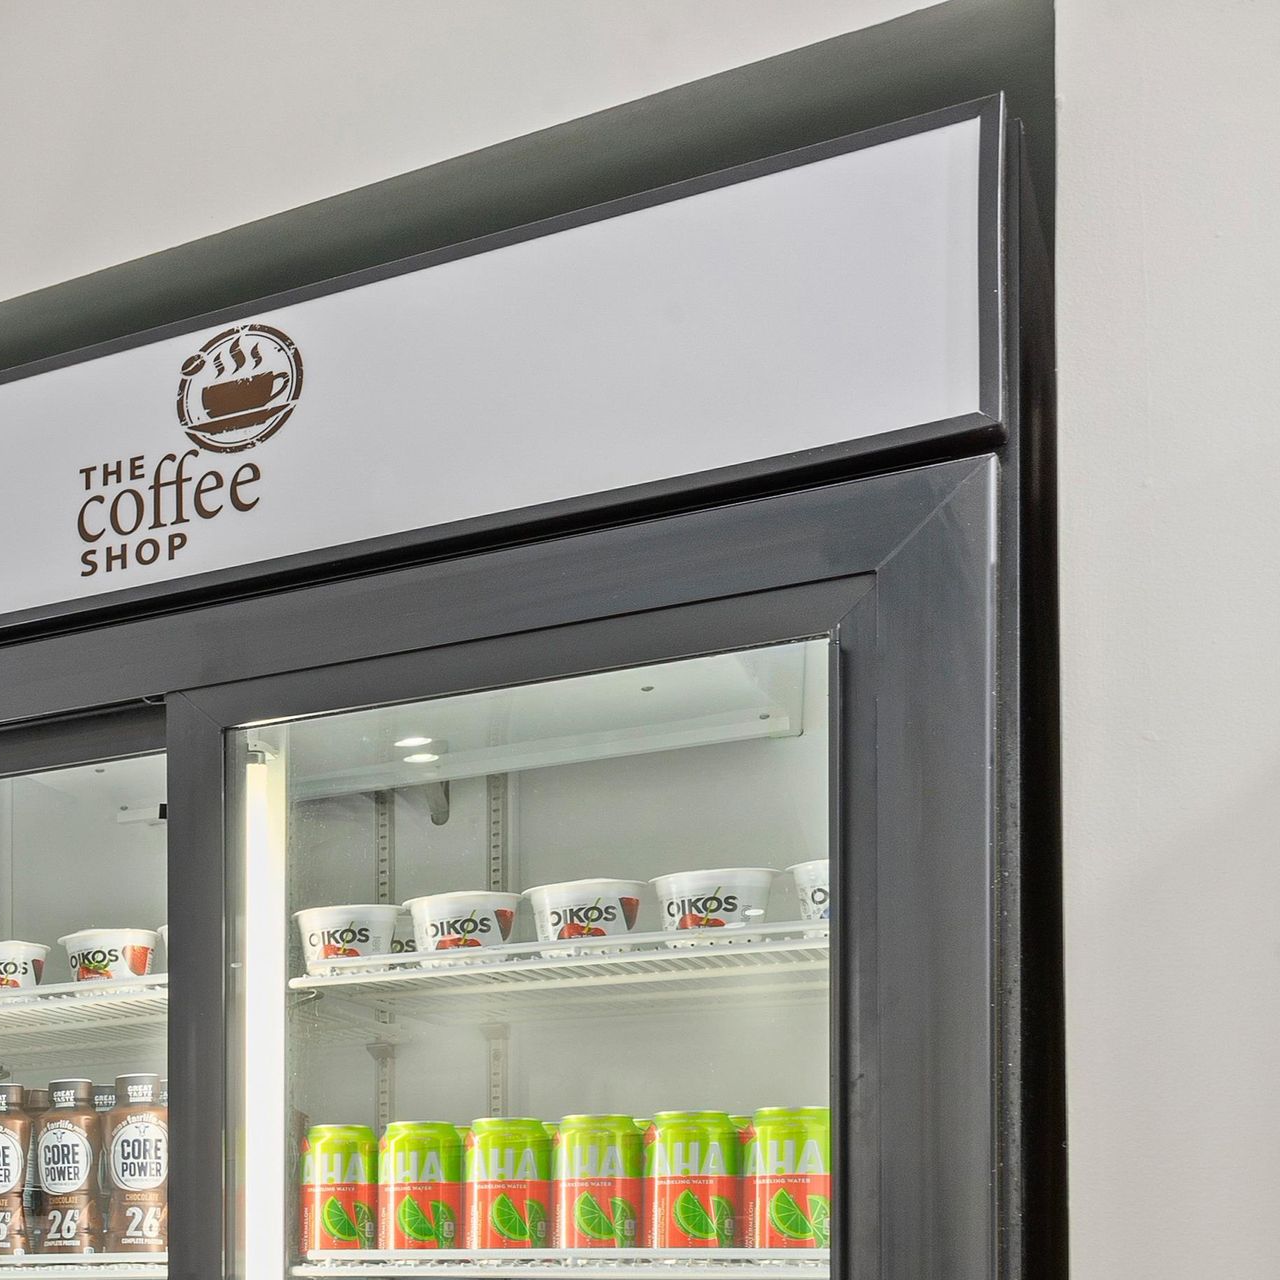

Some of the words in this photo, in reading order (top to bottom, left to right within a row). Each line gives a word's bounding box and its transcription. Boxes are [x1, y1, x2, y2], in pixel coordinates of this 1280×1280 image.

[79, 455, 145, 490] THE
[77, 449, 261, 543] coffee
[80, 533, 187, 577] SHOP
[549, 905, 617, 927] OIKOS
[667, 895, 738, 918] OIKOS
[308, 927, 370, 948] OIKOS
[426, 917, 491, 939] OIKOS
[70, 948, 119, 969] OIKOS
[43, 1143, 80, 1165] CORE
[121, 1138, 162, 1160] CORE
[552, 1145, 624, 1177] AHA
[644, 1142, 727, 1175] AHA
[744, 1140, 824, 1175] AHA
[45, 1166, 80, 1181] POWER
[121, 1162, 162, 1177] POWER
[303, 1152, 367, 1184] AHA
[379, 1151, 445, 1183] AHA
[467, 1148, 537, 1180] AHA
